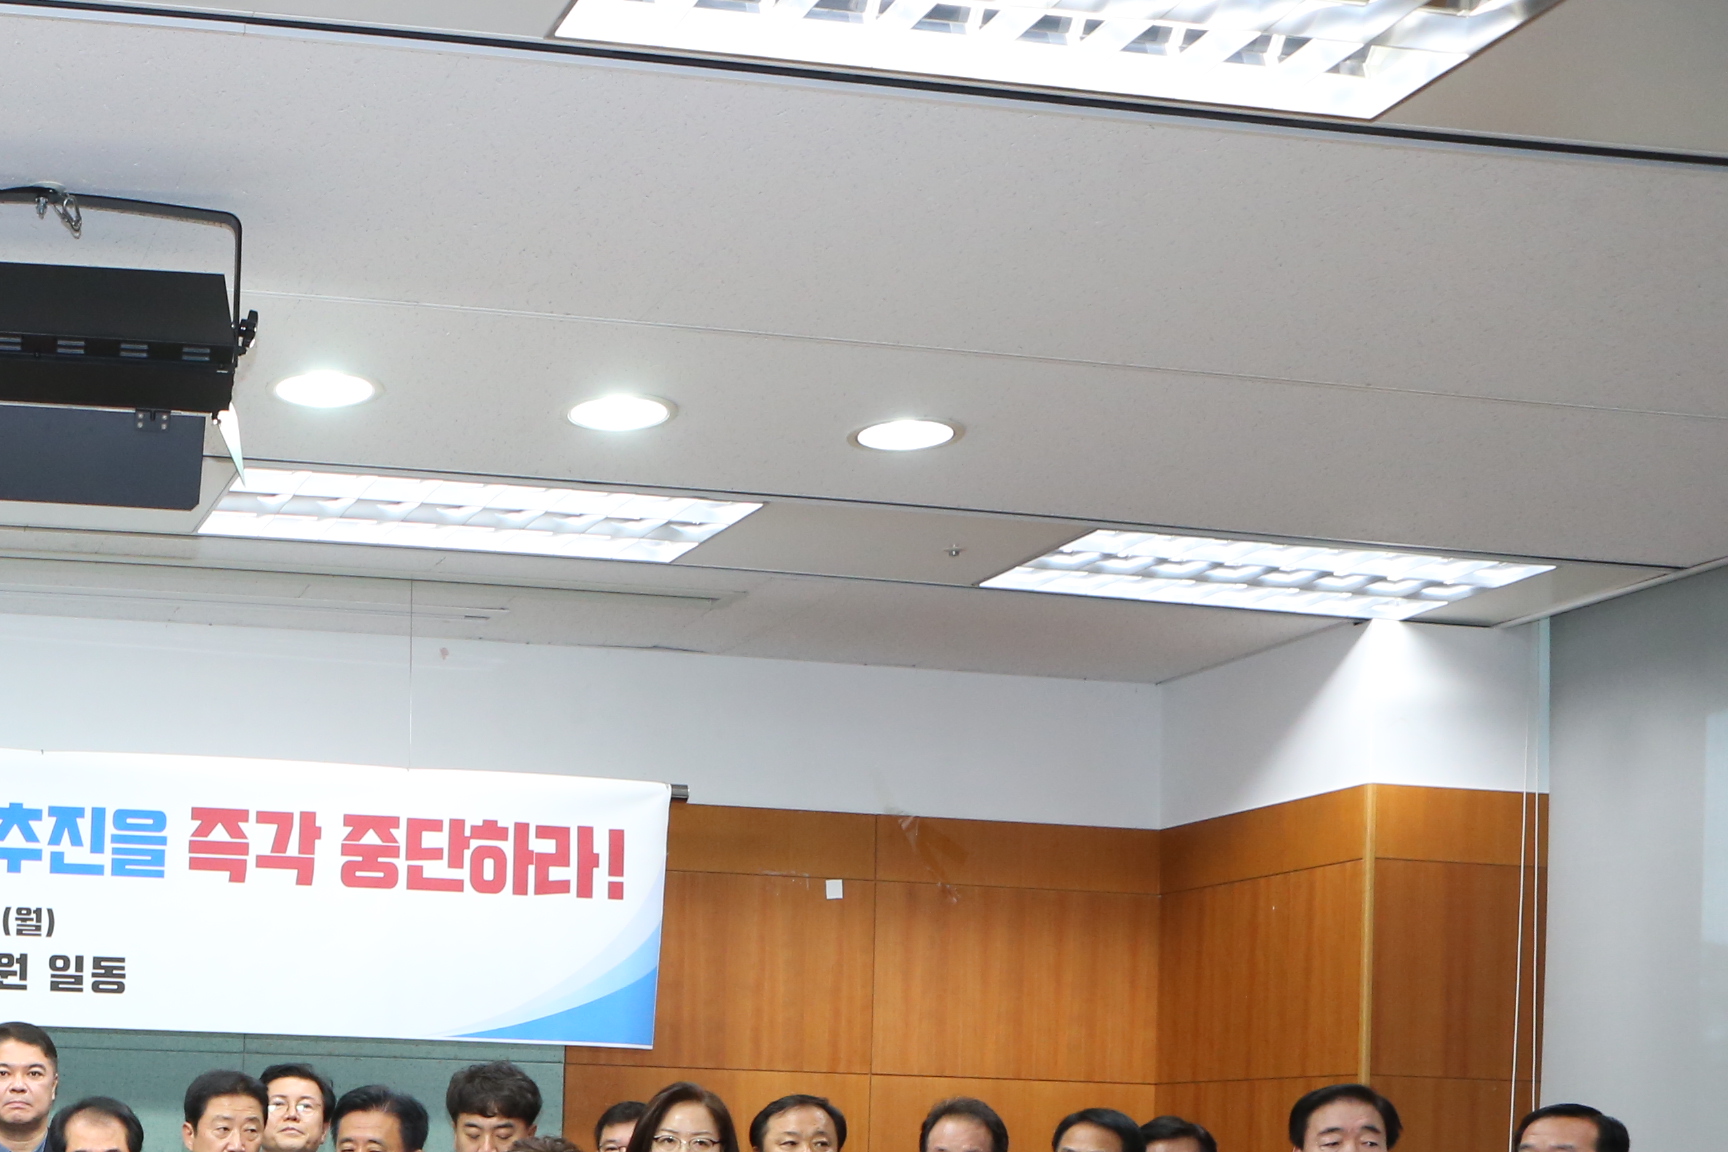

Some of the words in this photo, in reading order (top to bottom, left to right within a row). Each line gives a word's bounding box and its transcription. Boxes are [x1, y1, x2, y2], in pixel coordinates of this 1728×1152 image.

[189, 808, 321, 885] 즉각
[341, 815, 624, 899] 중단하라!
[3, 907, 54, 937] (월)
[49, 955, 125, 993] 일동
